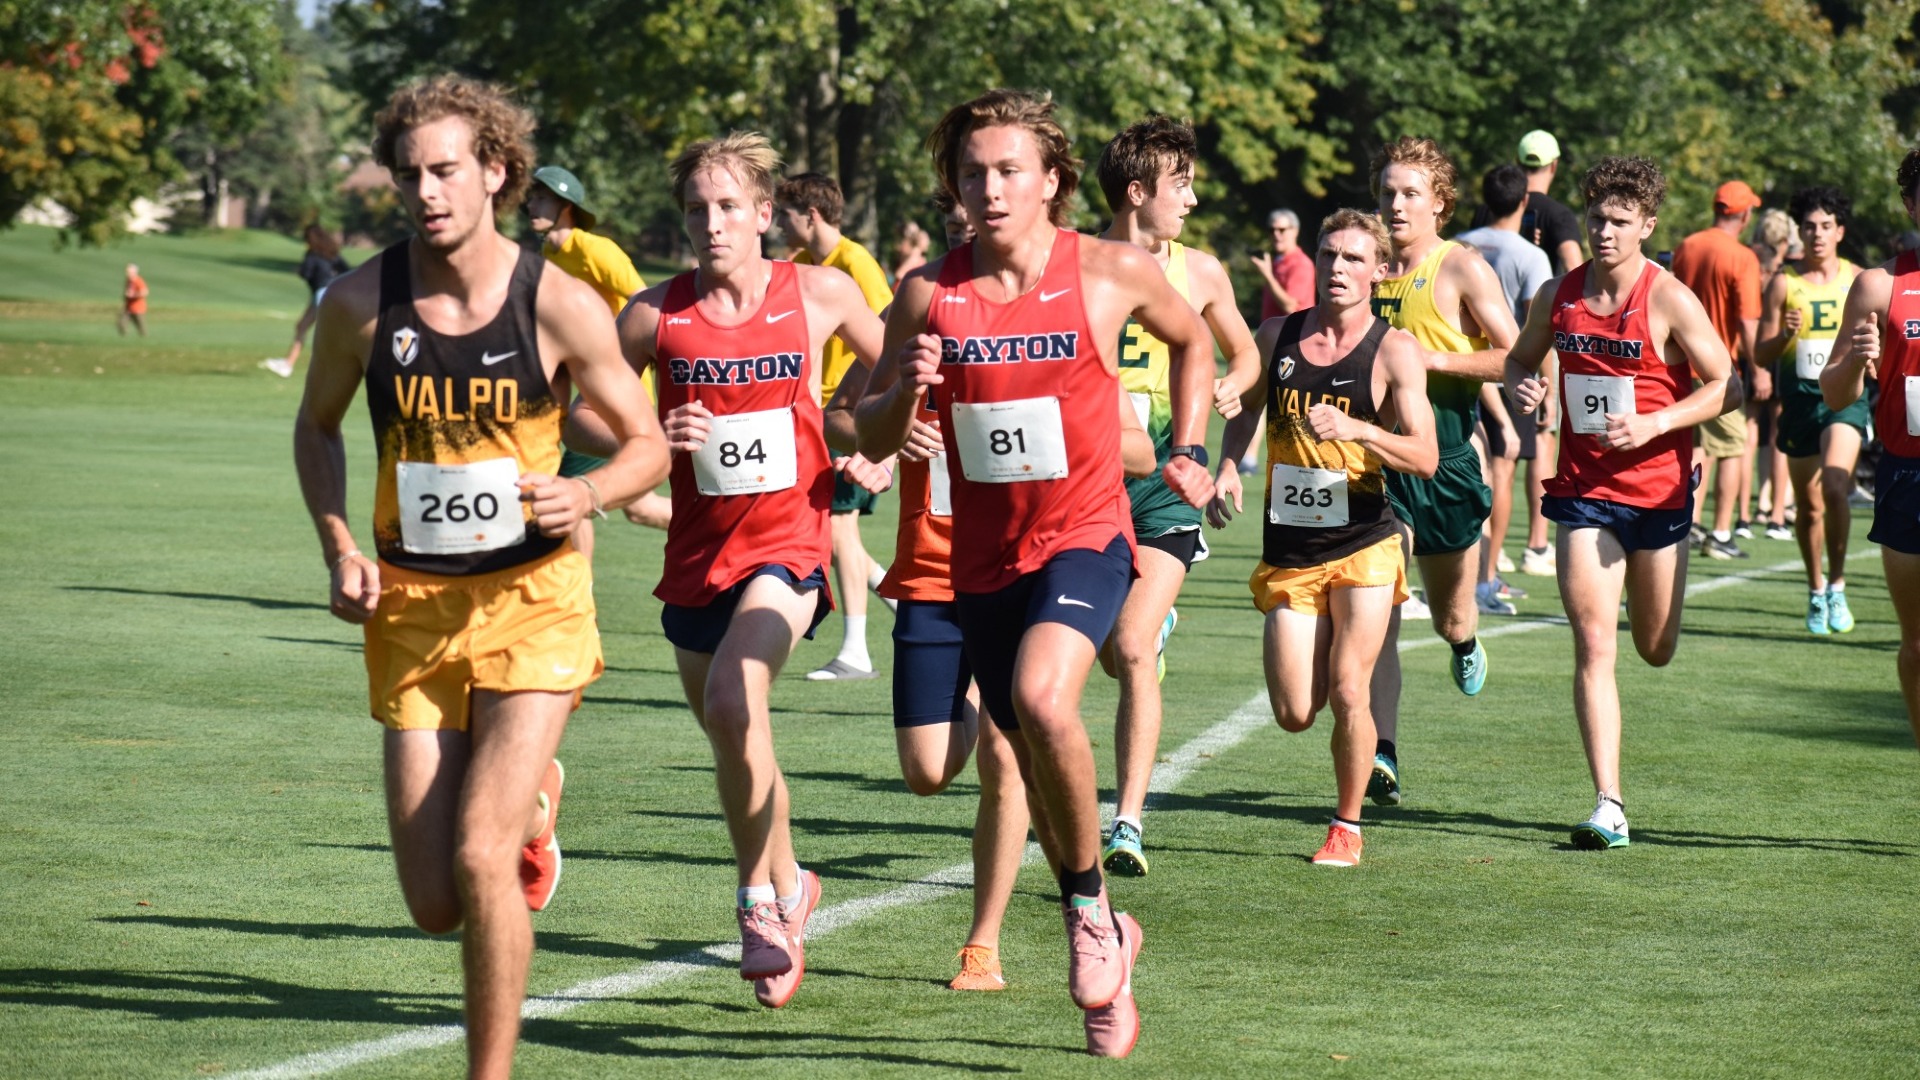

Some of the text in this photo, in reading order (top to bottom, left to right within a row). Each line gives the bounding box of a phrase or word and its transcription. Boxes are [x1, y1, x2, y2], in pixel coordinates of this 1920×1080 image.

[1809, 300, 1837, 331] E
[939, 331, 1078, 365] DAYTON
[1118, 316, 1150, 369] E
[1554, 331, 1643, 360] DAYTON
[669, 352, 804, 386] DAYTON
[1807, 352, 1829, 366] 10
[395, 374, 518, 423] VALPO
[1584, 394, 1609, 414] 91
[719, 438, 767, 468] 84
[989, 427, 1026, 456] 81
[419, 492, 498, 523] 260
[1284, 484, 1333, 508] 263
